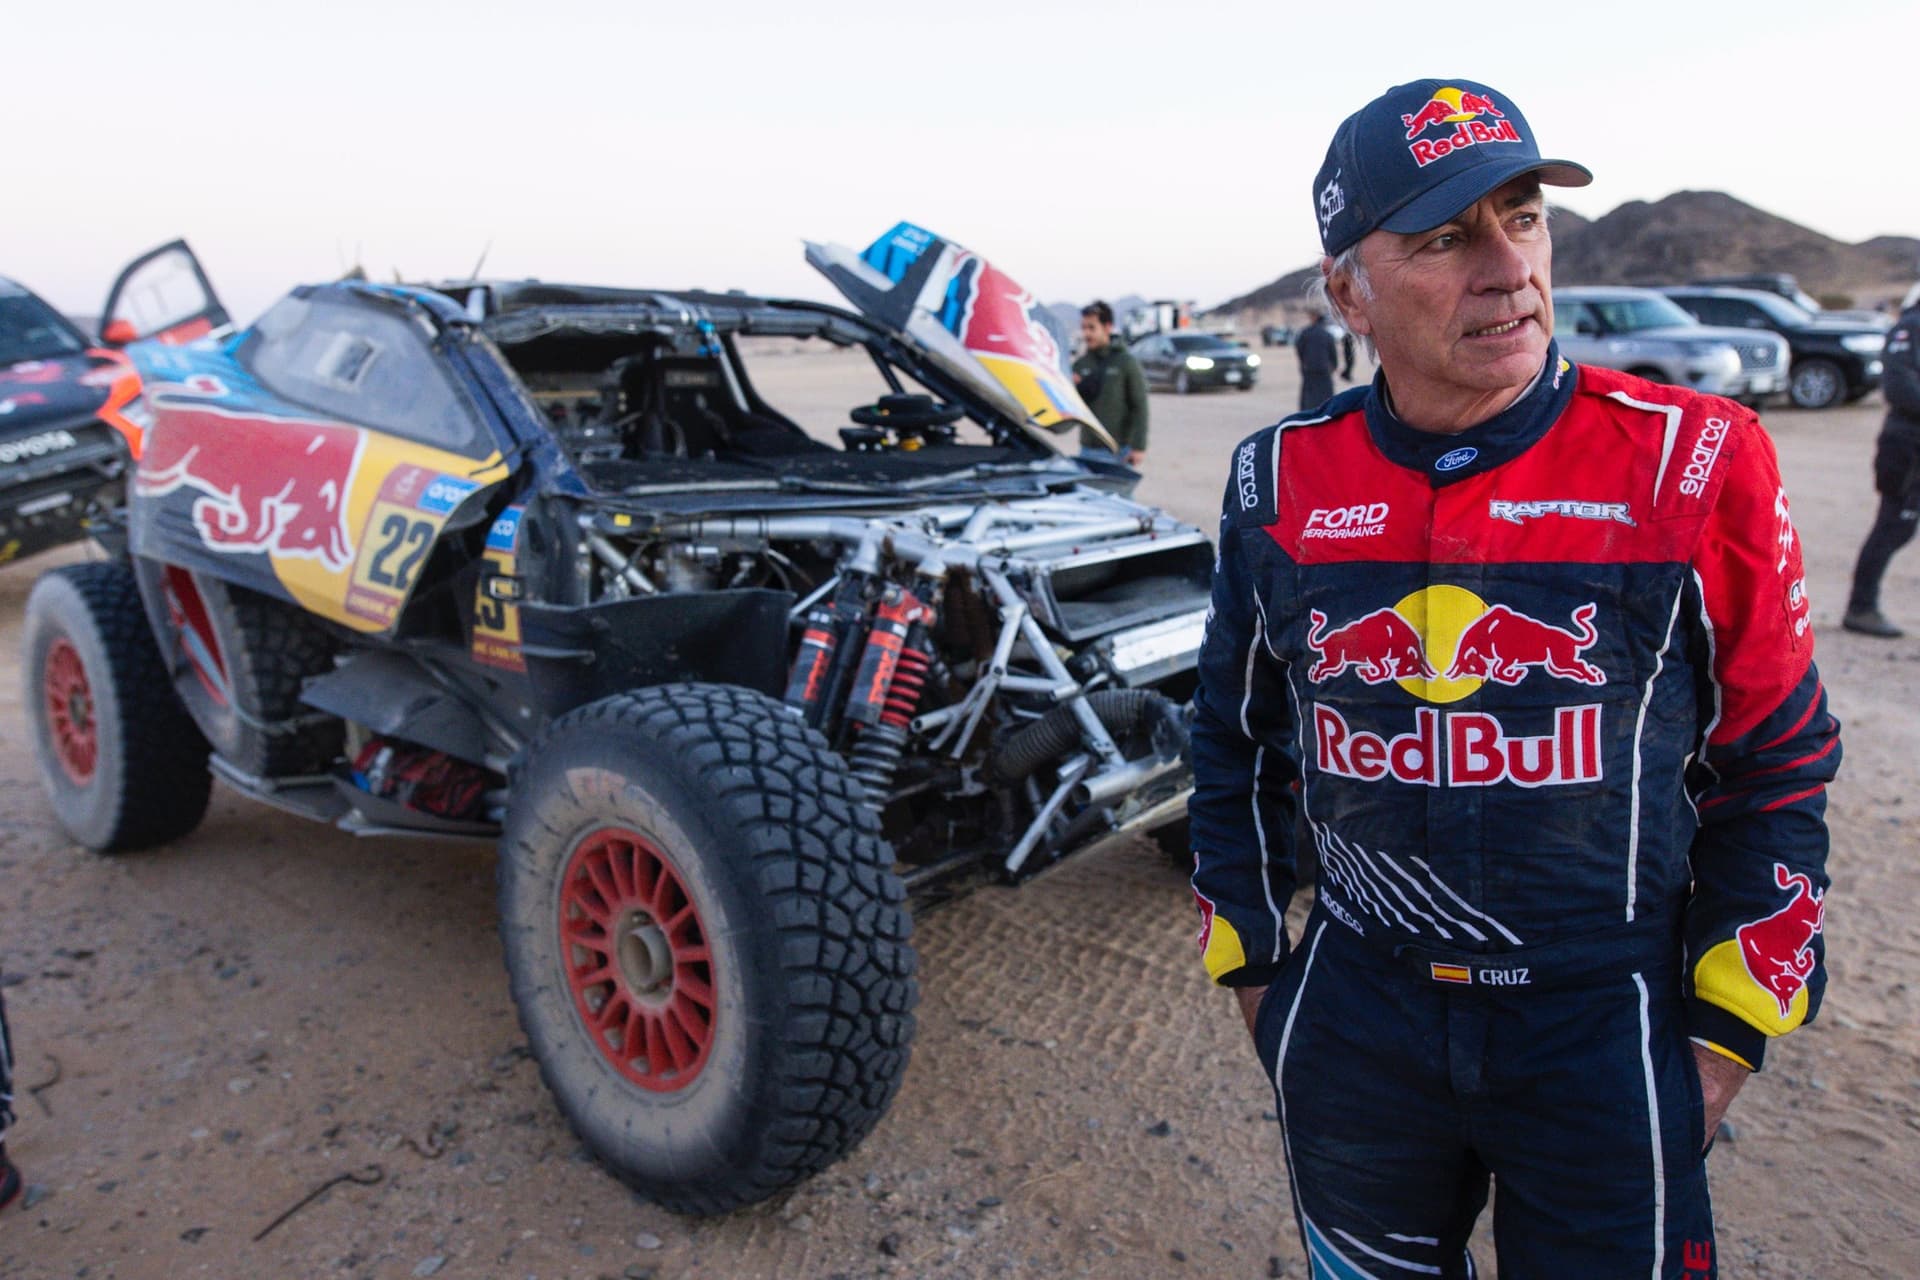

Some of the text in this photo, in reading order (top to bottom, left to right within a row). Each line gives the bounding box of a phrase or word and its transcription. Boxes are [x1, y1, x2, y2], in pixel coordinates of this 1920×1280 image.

[1408, 120, 1521, 168] Red Bull
[0, 430, 77, 464] OYOTA
[1444, 451, 1470, 468] Ford
[1679, 417, 1730, 499] sparco
[1237, 442, 1259, 511] sparco
[1306, 502, 1389, 529] FORD
[1489, 500, 1637, 528] RAPTOR
[1302, 524, 1386, 540] PERFORMANCE
[1314, 702, 1603, 788] Red Bull
[1320, 886, 1365, 937] sparco
[1479, 968, 1532, 986] CRUZ
